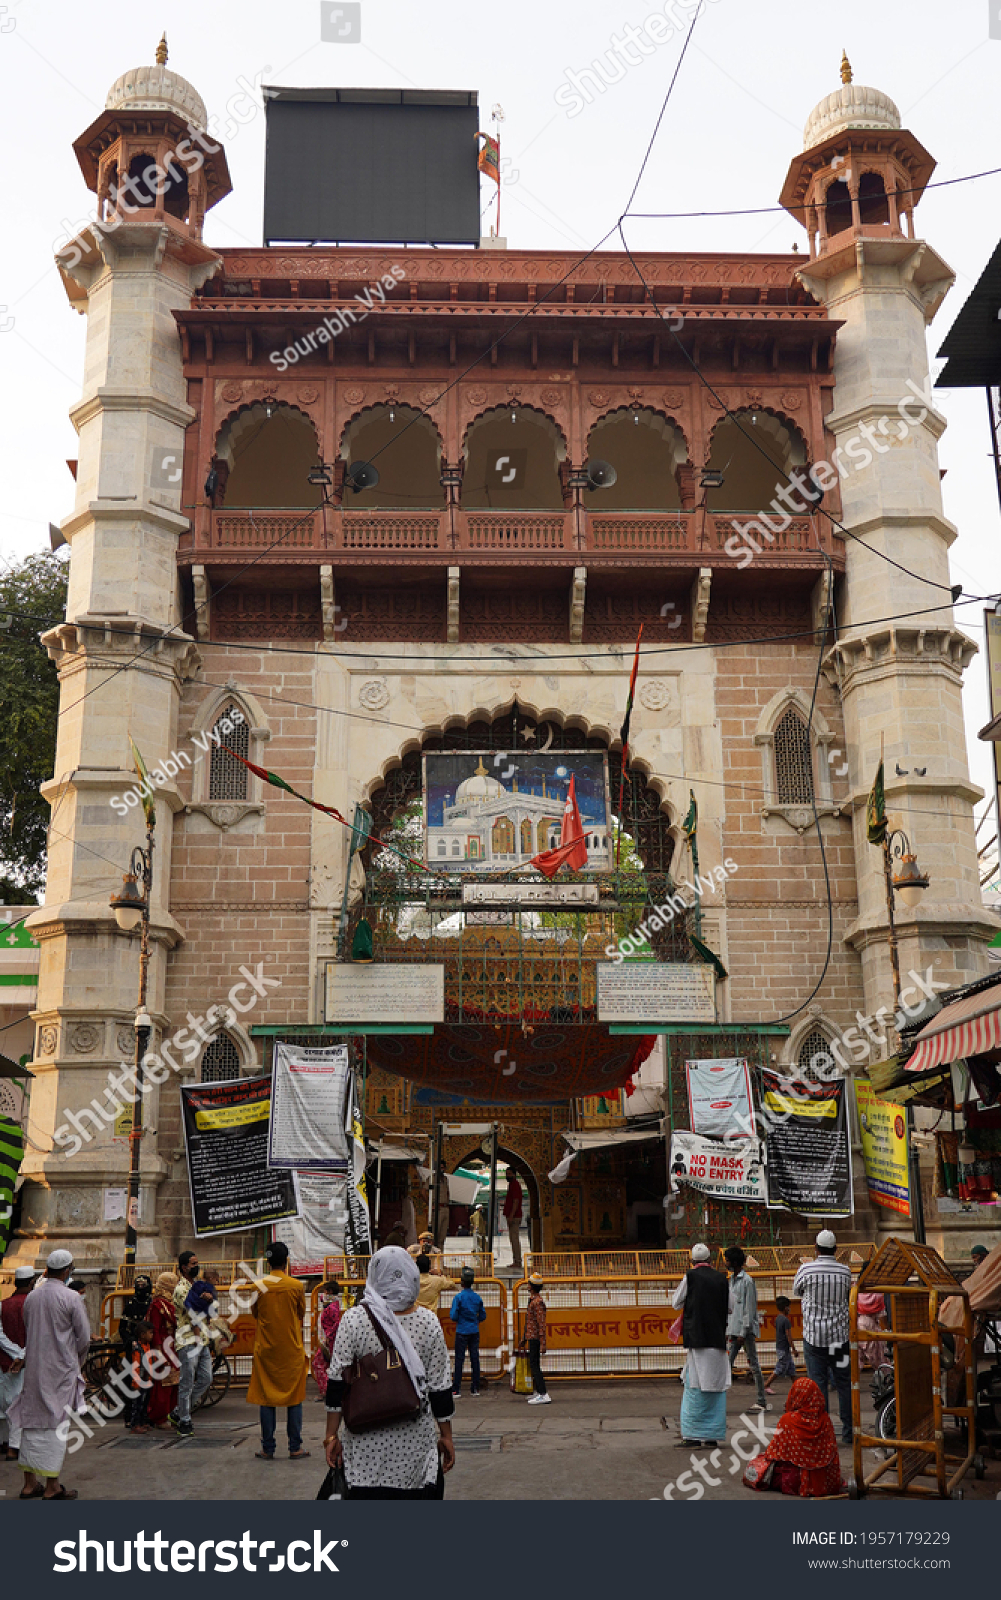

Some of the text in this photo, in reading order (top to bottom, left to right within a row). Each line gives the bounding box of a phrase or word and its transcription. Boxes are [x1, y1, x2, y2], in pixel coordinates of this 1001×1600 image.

[690, 1155, 744, 1170] NO MASK
[689, 1166, 744, 1181] NO ENTRY
[546, 1321, 620, 1338] ाजस्थान
